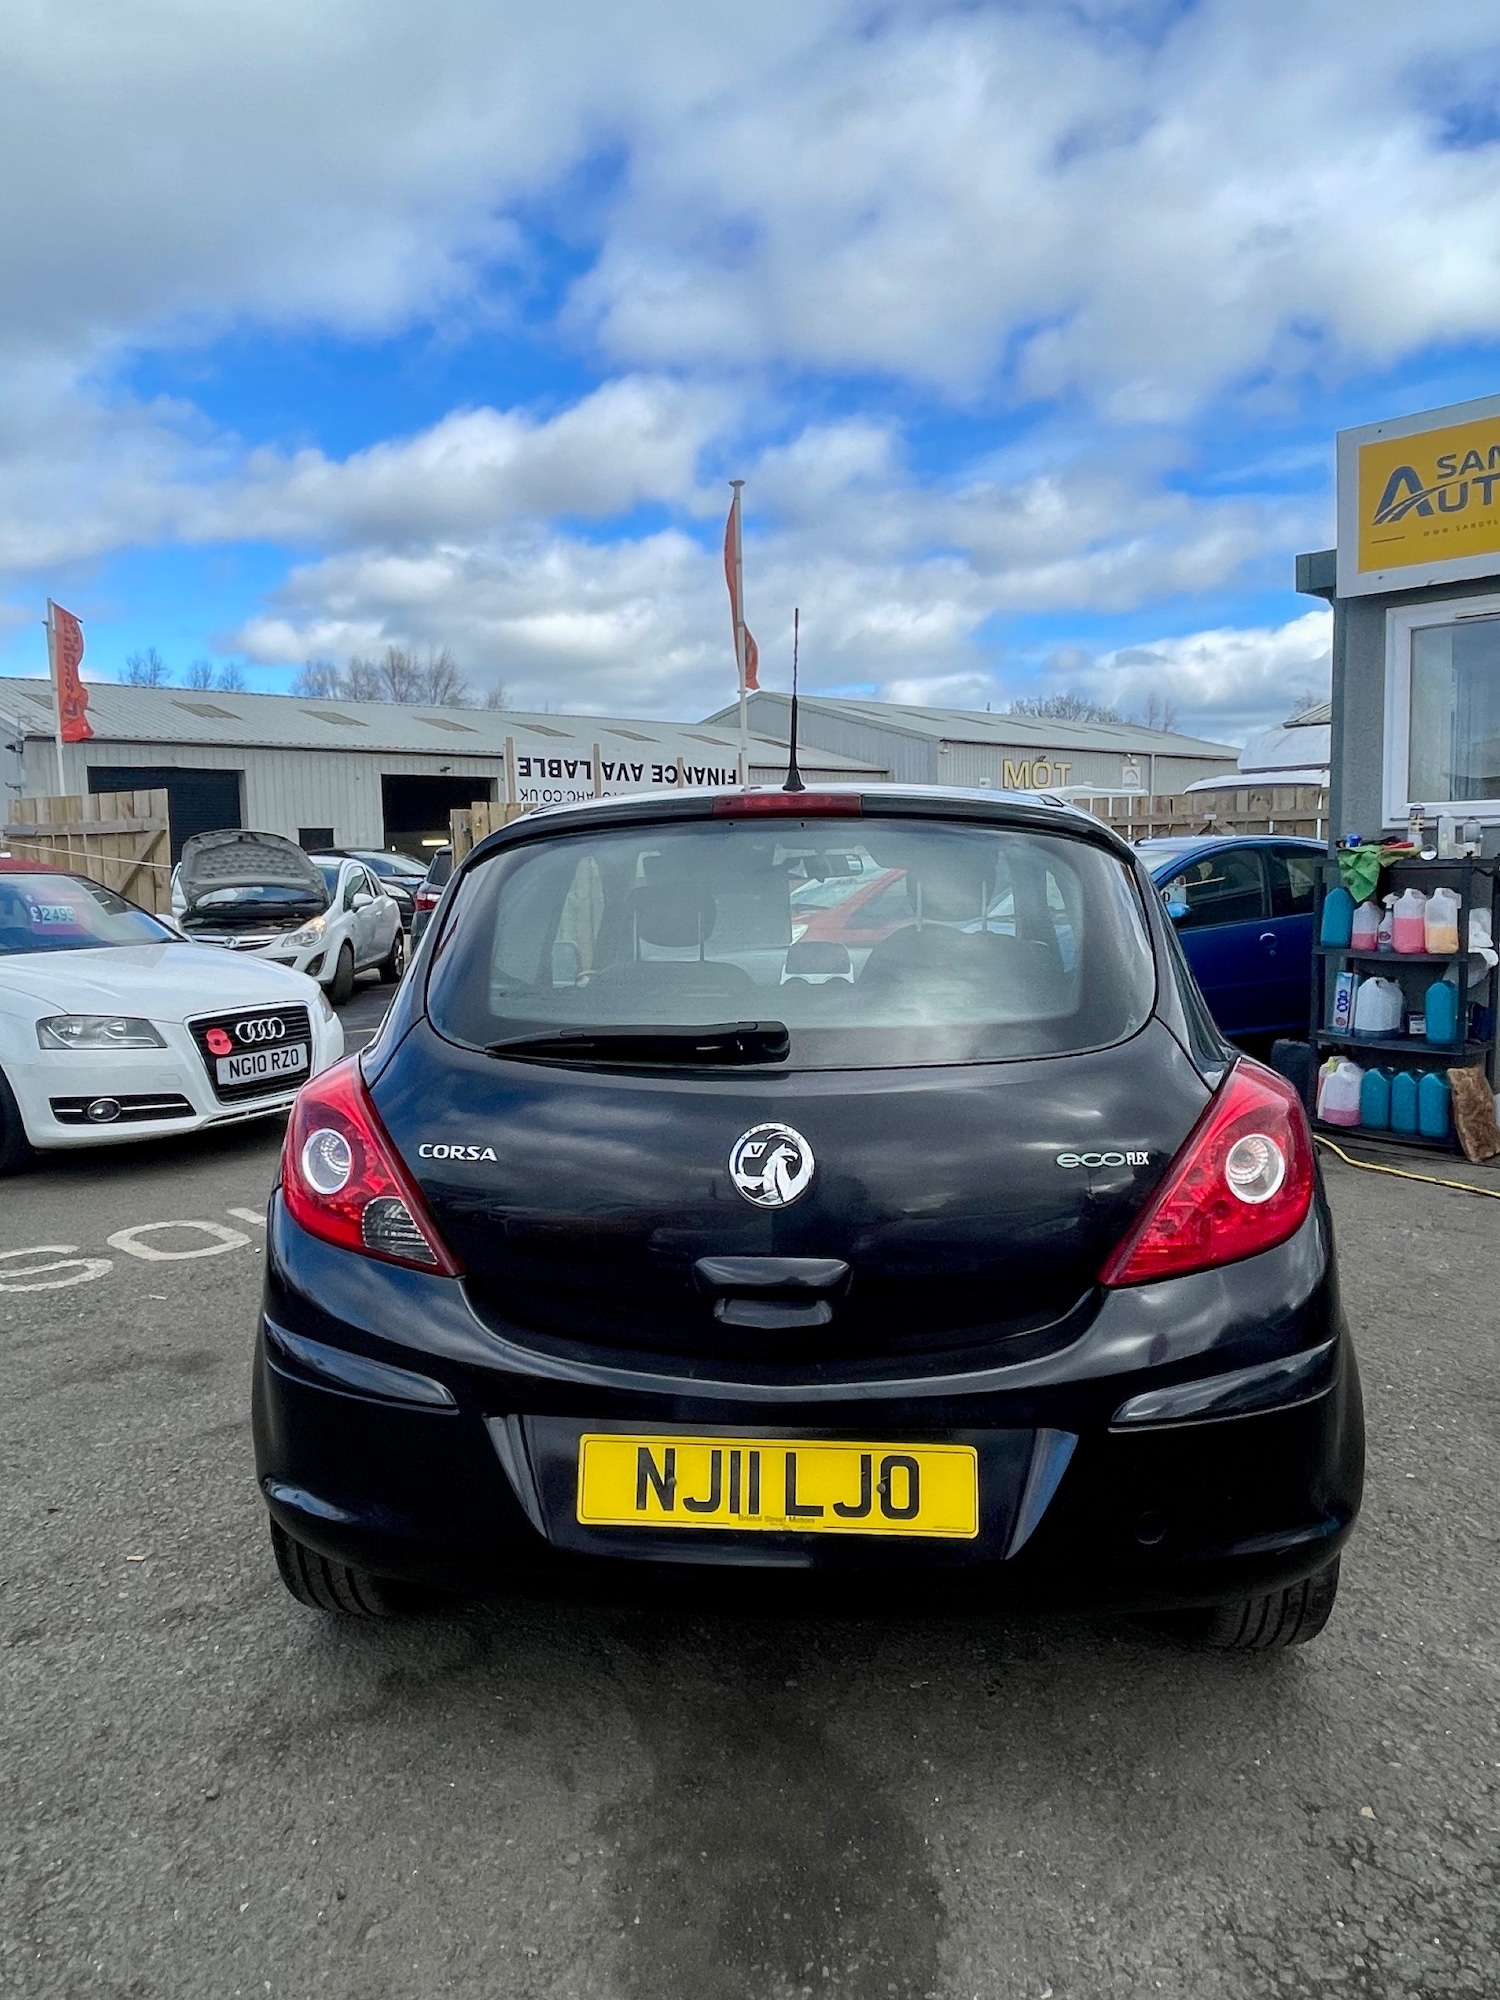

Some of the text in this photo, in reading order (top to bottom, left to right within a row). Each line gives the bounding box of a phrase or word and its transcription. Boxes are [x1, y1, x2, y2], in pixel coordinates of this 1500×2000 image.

[518, 757, 644, 782] AVALABLE
[1003, 758, 1072, 788] MOT
[229, 1055, 267, 1078] NG10
[418, 1143, 498, 1161] CORSA
